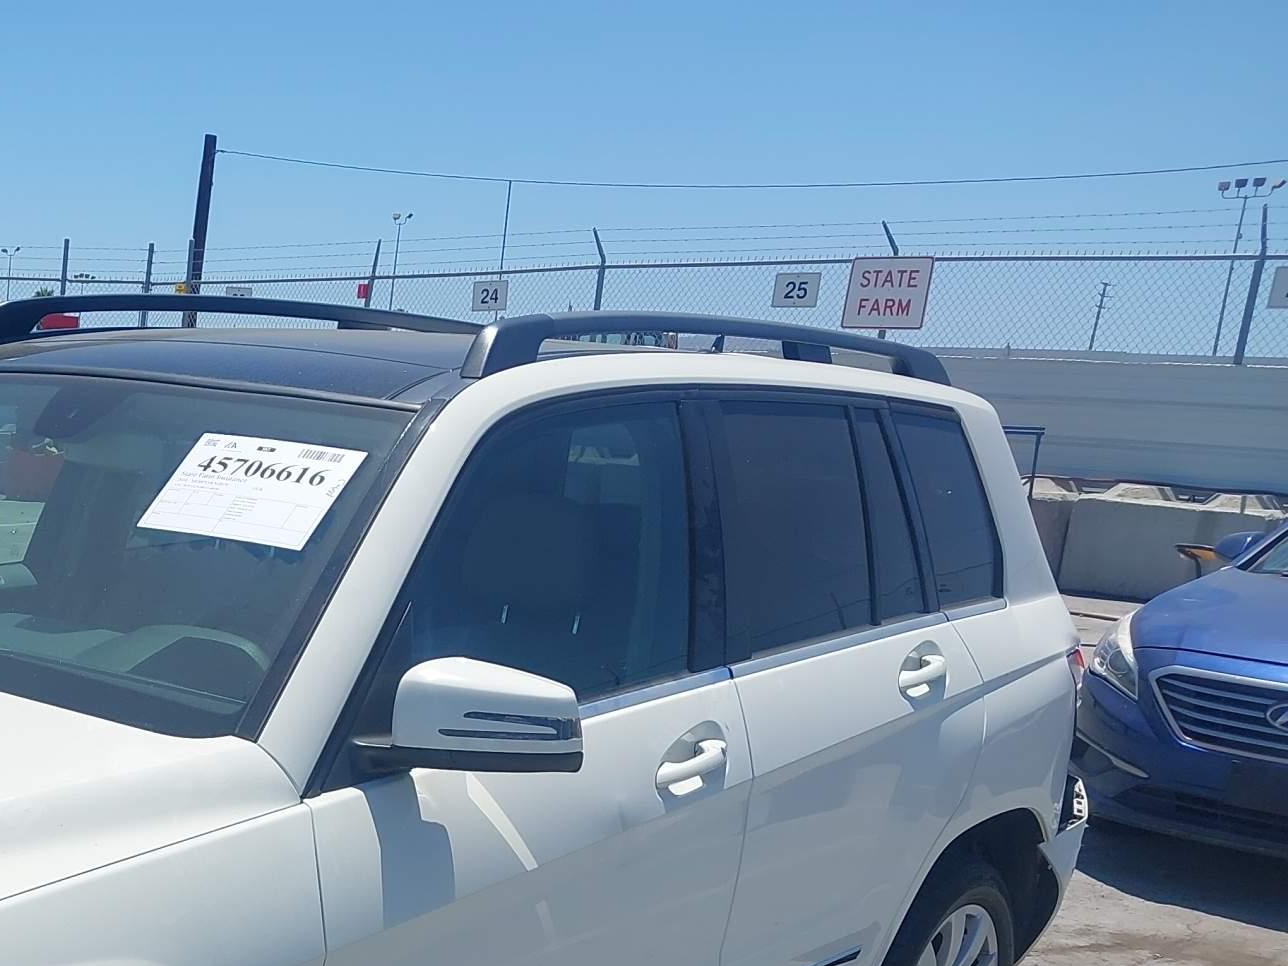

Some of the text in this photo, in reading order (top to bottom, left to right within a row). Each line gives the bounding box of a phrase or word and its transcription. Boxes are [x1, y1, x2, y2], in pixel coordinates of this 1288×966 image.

[860, 269, 920, 288] STATE
[480, 287, 499, 304] 24
[783, 281, 809, 300] 25
[857, 298, 912, 317] FARM
[197, 455, 331, 487] 45706616
